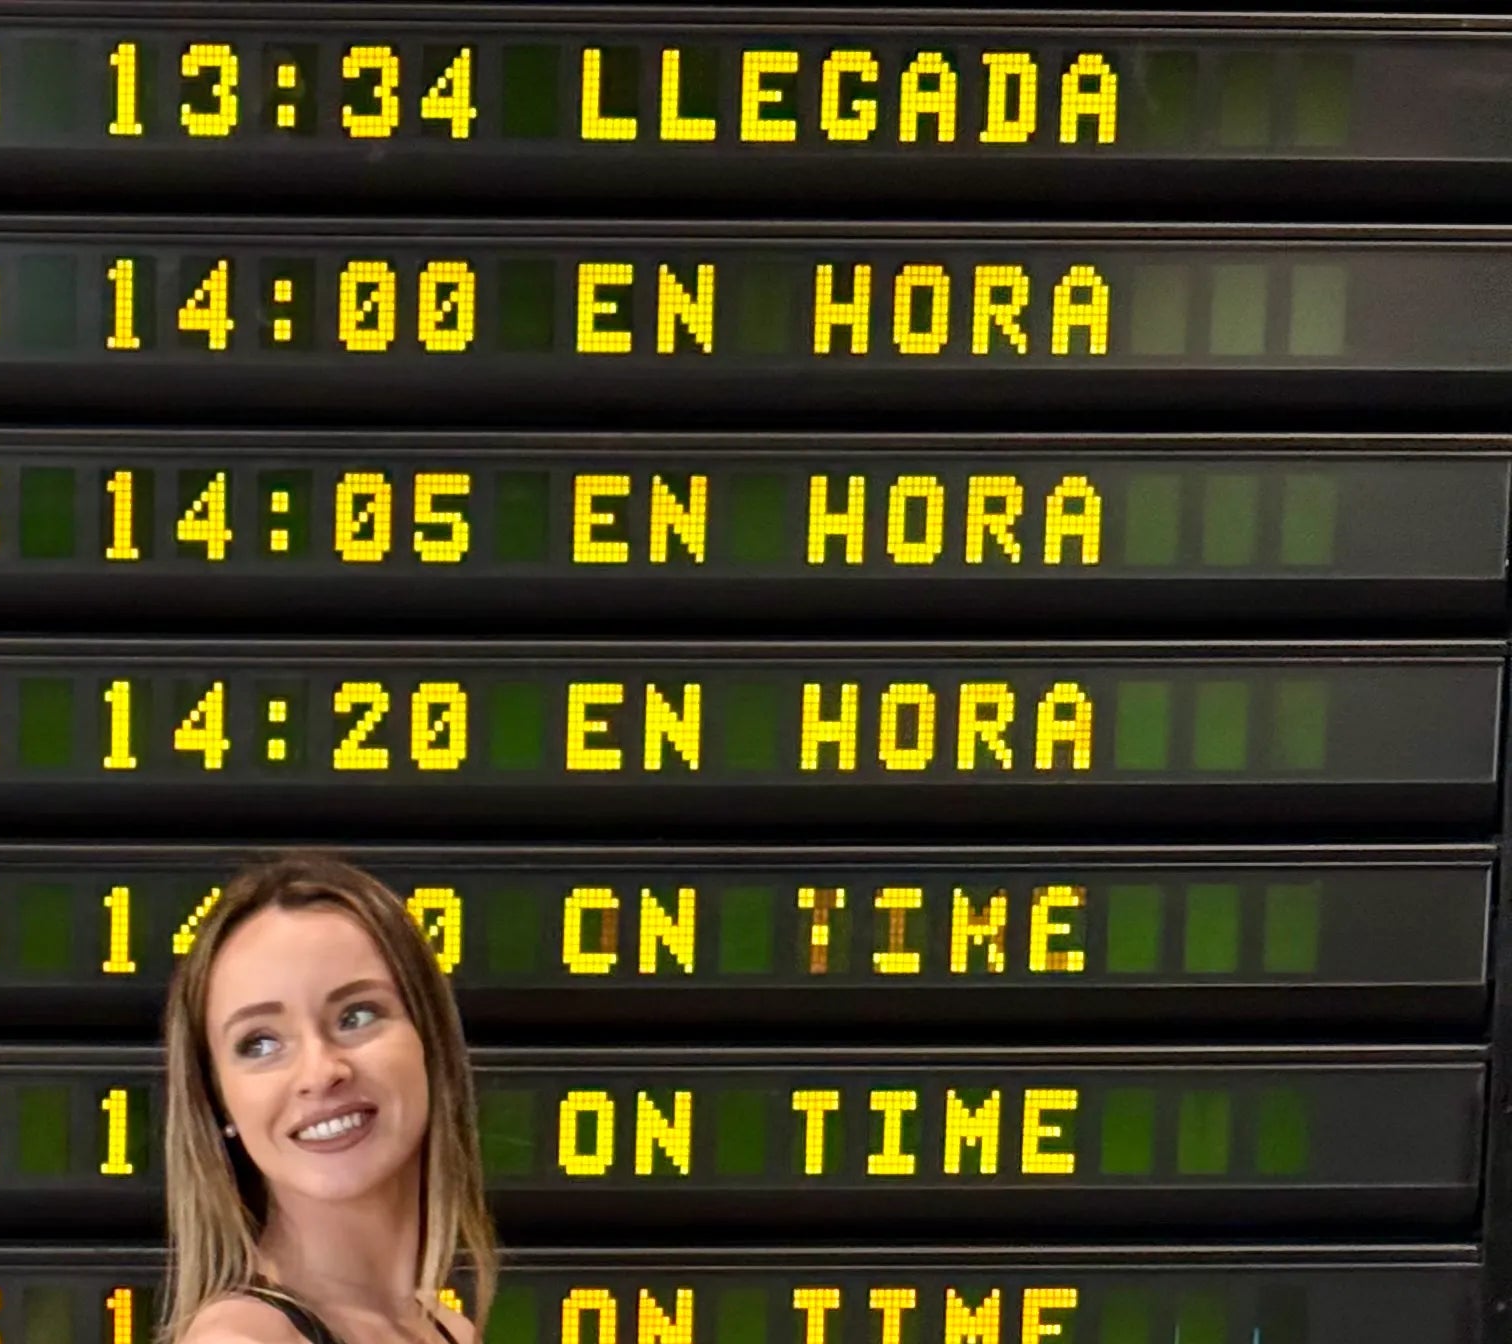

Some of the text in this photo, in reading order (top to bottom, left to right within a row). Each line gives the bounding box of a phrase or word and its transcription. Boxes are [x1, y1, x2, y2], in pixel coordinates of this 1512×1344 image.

[110, 44, 476, 138] 13:34
[582, 49, 1116, 143] LLEGADA
[107, 260, 475, 351] 14:00
[577, 264, 714, 353] EN
[814, 265, 1108, 354] HORA
[106, 472, 470, 562] 14:05
[574, 475, 707, 562] EN
[808, 476, 1101, 564] HORA
[104, 681, 467, 770] 14:20
[567, 684, 700, 770] EN
[801, 683, 1092, 770] HORA
[559, 1092, 691, 1175] ON
[793, 1090, 1078, 1174] TIME
